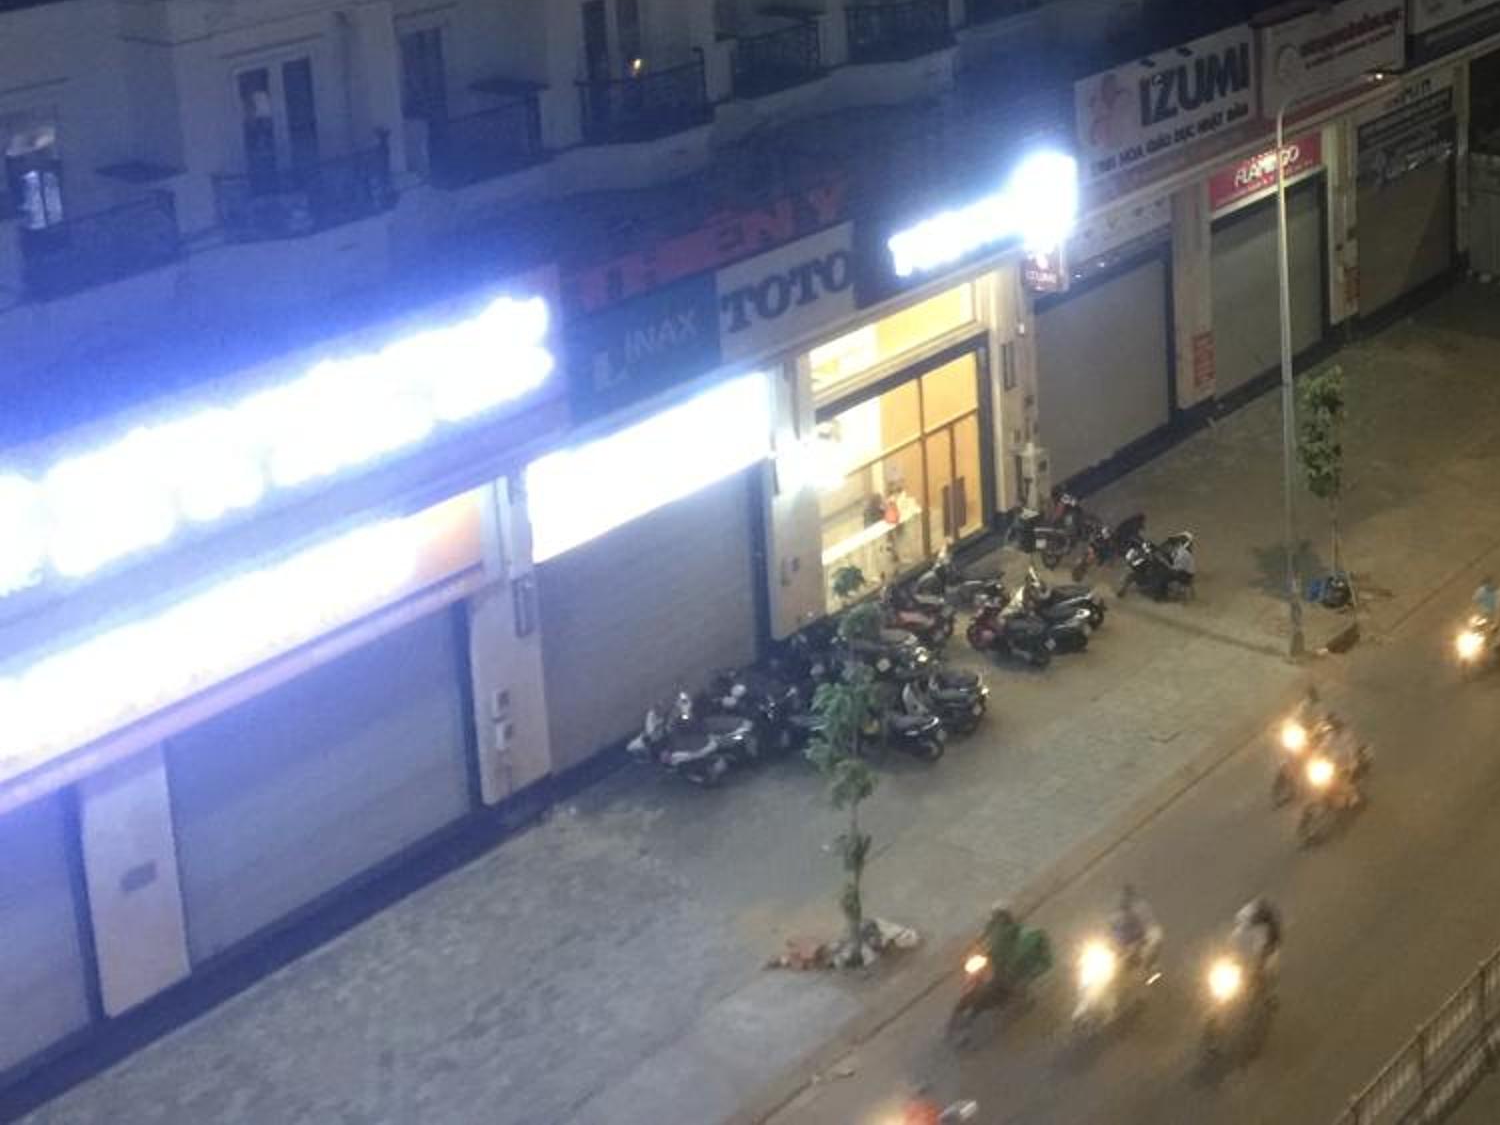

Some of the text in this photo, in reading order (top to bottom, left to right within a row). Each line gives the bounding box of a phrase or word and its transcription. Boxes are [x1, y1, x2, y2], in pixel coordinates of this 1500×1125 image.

[1139, 42, 1249, 127] IZUMI
[721, 249, 849, 333] TOTO
[624, 308, 698, 362] INAX
